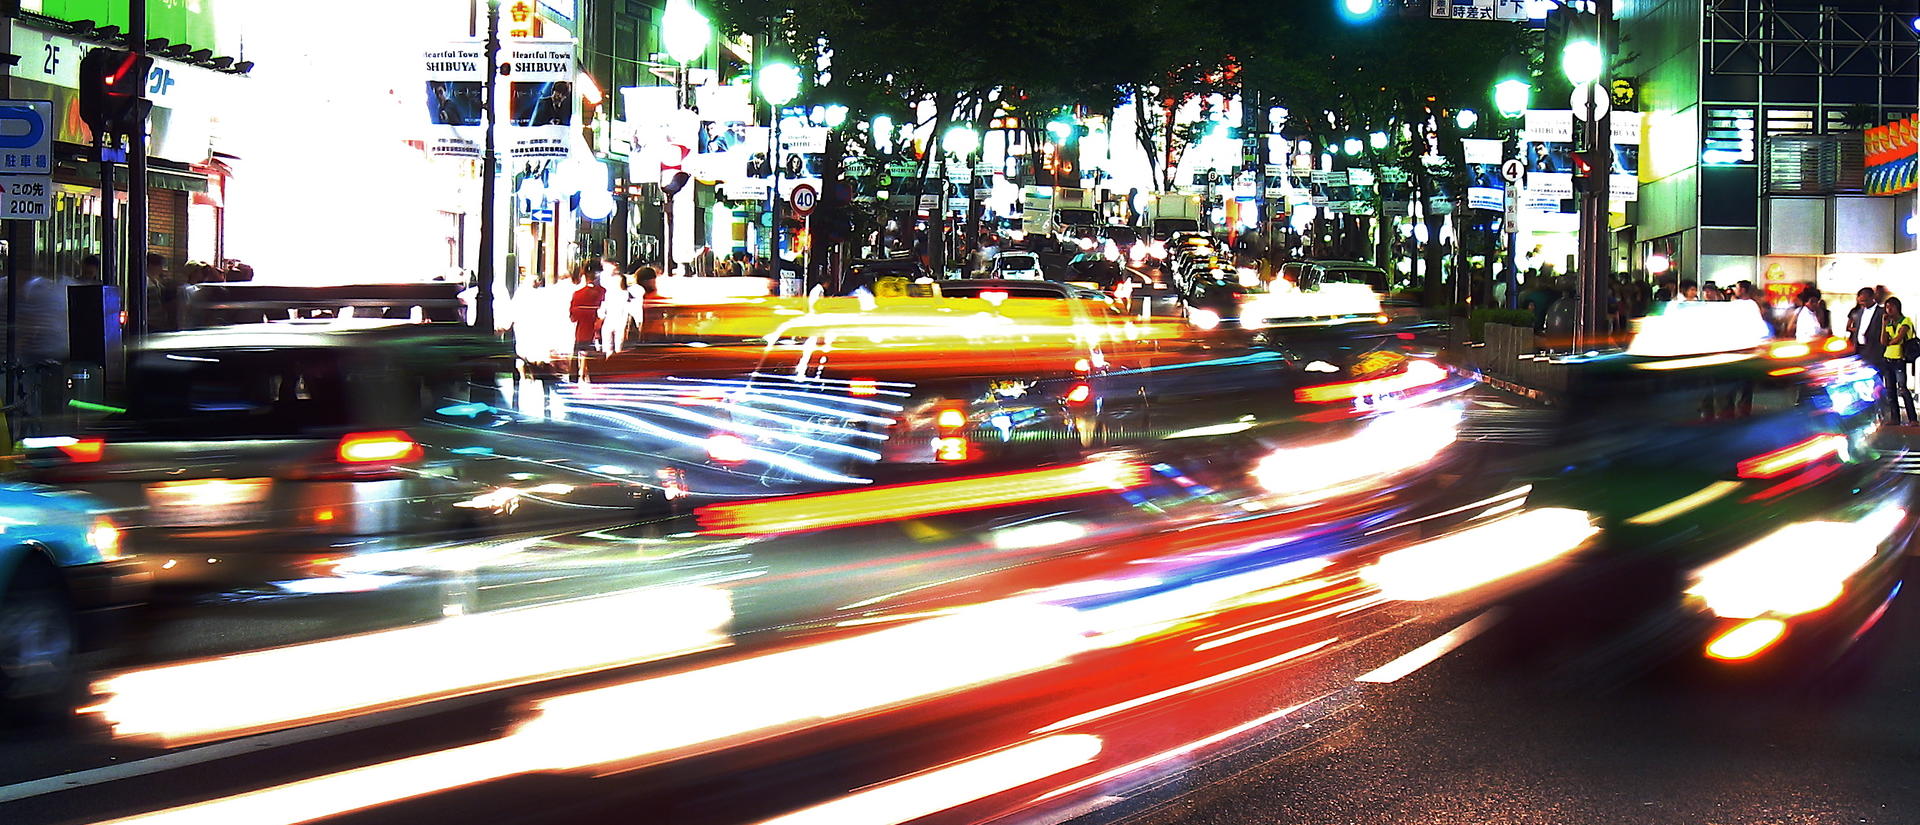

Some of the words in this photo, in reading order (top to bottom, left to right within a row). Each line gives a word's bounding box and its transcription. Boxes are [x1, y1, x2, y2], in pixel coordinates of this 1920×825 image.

[1453, 6, 1493, 19] 時差式
[44, 43, 60, 75] 2F
[512, 51, 548, 59] Heartful
[549, 51, 571, 59] Town
[426, 62, 477, 72] SHIBUYA
[515, 62, 567, 73] SHIBUYA
[5, 153, 47, 168] 駐車場
[1506, 162, 1518, 179] 4
[11, 182, 44, 196] この先
[797, 192, 813, 207] 40
[10, 200, 44, 214] 200m
